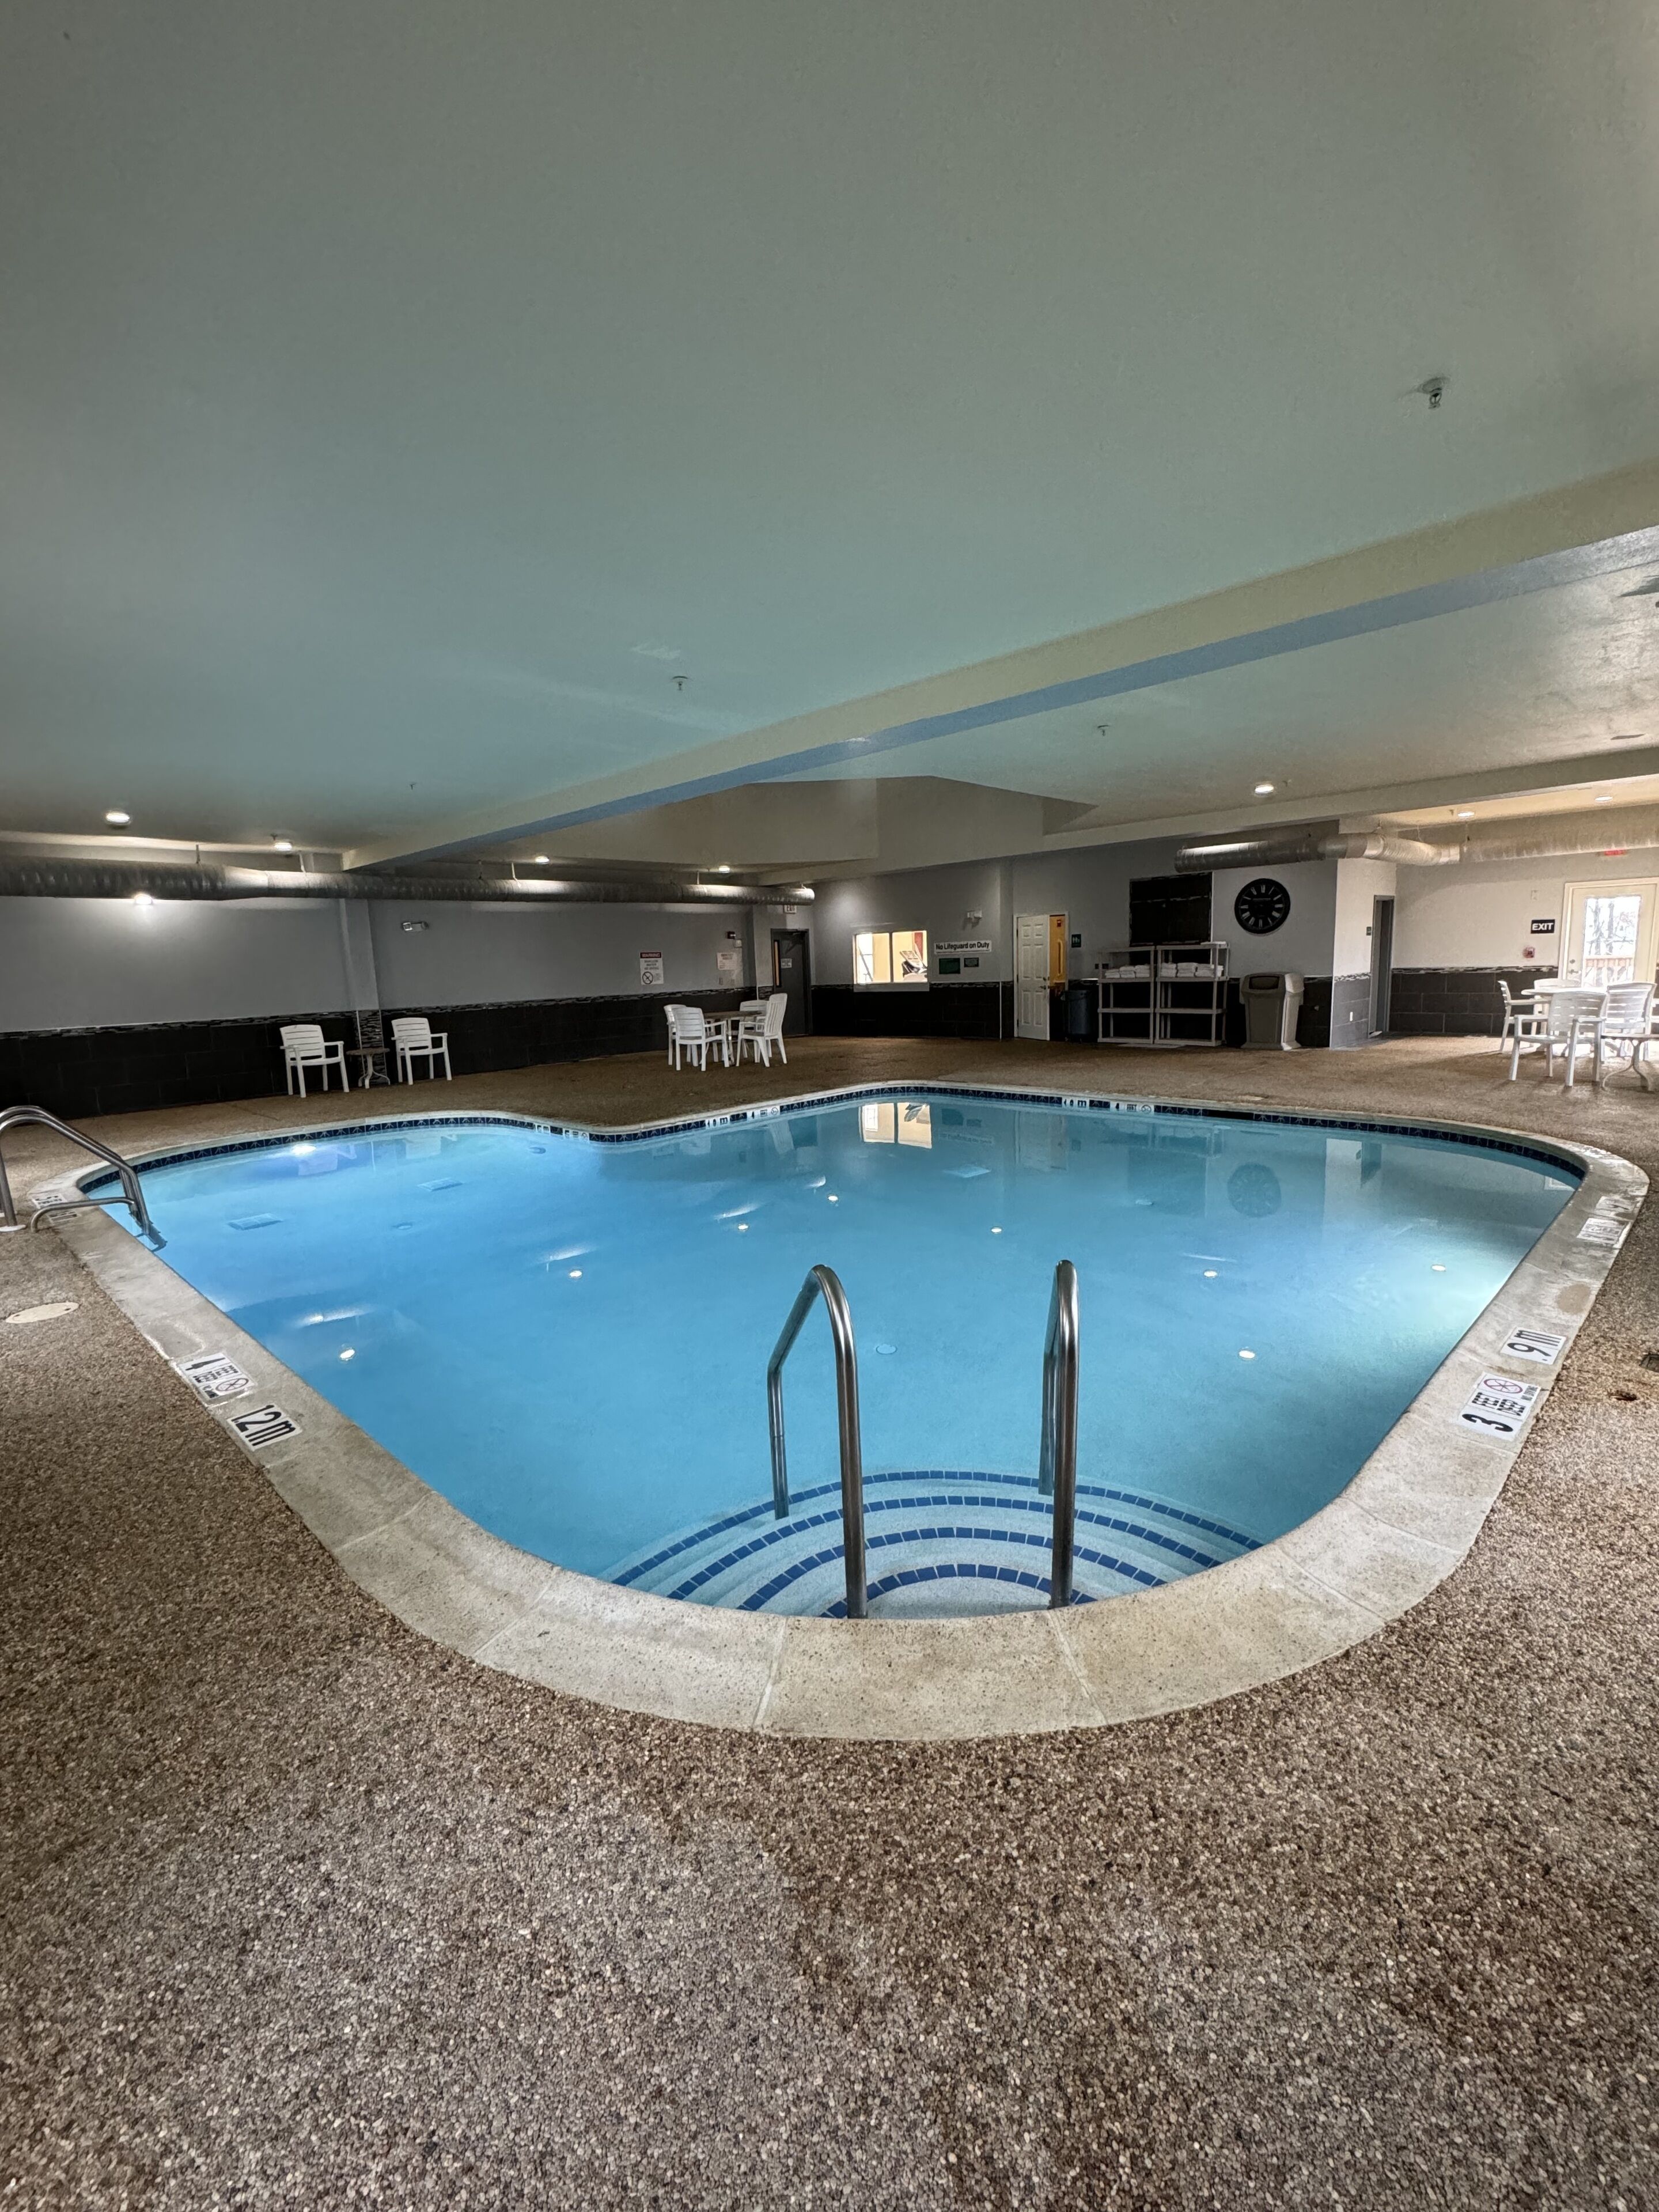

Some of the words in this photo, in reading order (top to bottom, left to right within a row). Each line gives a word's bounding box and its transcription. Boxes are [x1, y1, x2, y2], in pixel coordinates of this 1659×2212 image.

[1532, 922, 1554, 931] EXIT
[944, 942, 968, 950] Lifeguard
[1471, 1392, 1501, 1409] FEET
[1497, 1399, 1526, 1416] DEEP
[1461, 1414, 1514, 1433] 3
